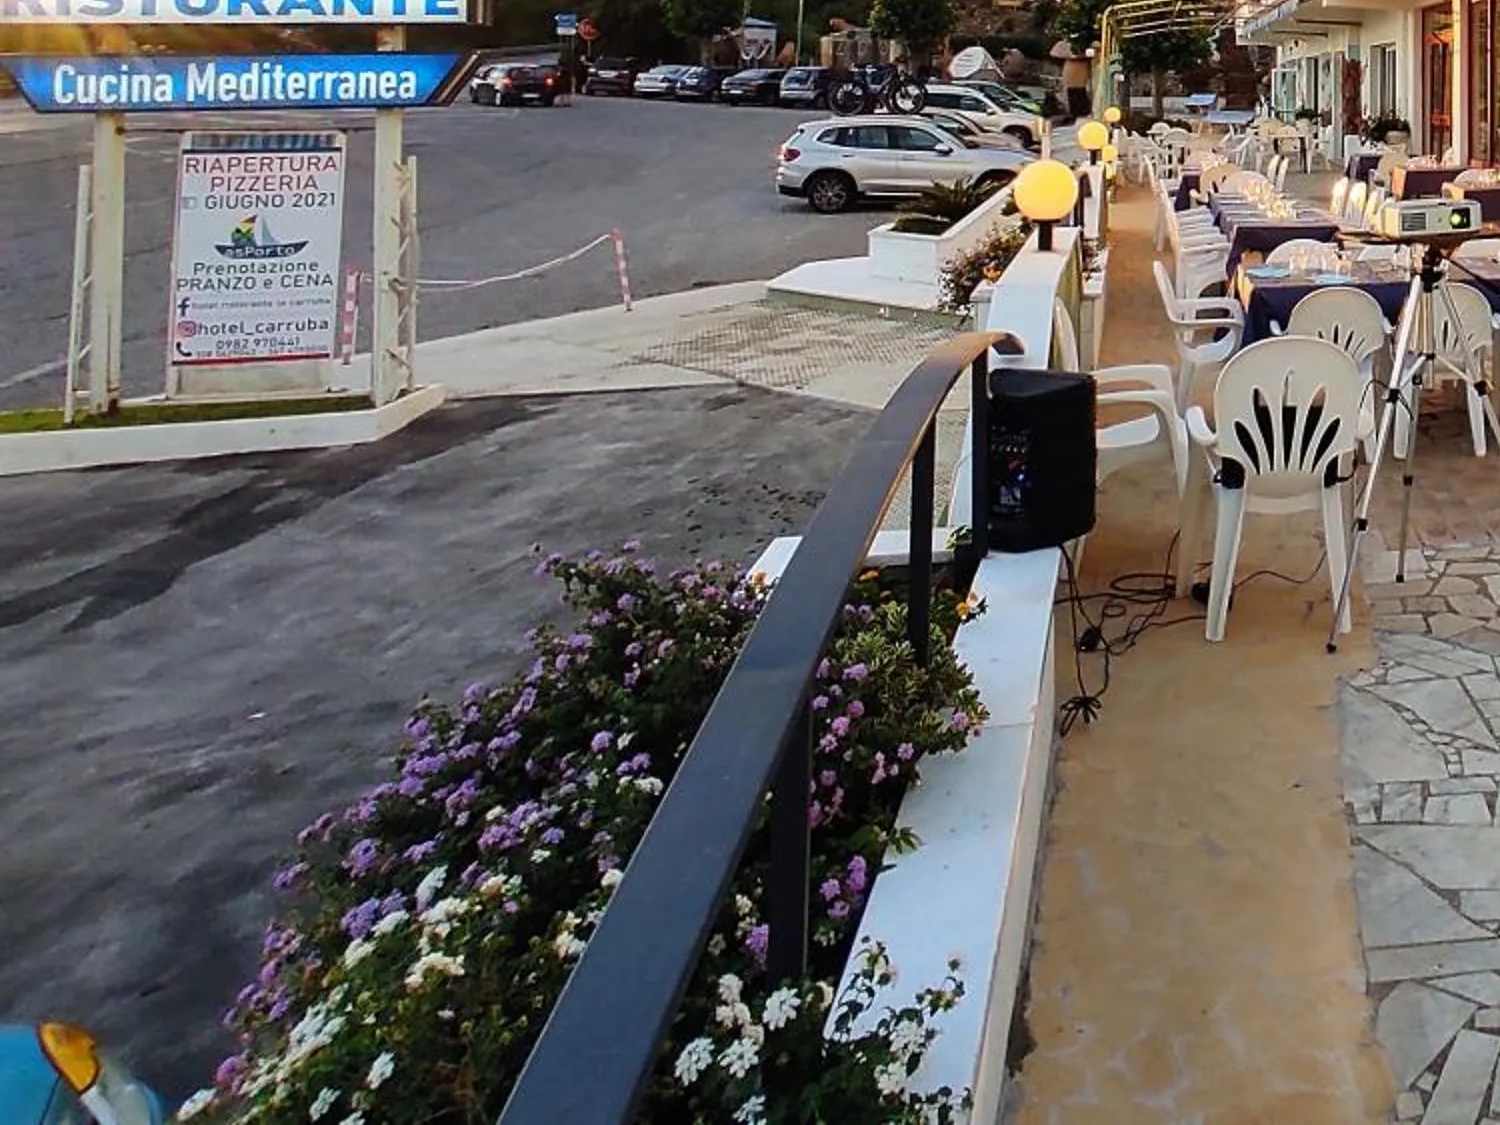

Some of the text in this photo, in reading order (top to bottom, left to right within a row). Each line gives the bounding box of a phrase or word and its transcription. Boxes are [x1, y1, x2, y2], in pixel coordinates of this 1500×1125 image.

[54, 62, 418, 105] Cucina Mediterranea
[185, 155, 338, 174] RIAPERTURA
[210, 175, 319, 192] PIZZERIA
[204, 194, 285, 210] GIUGNO
[291, 192, 336, 208] 2021
[193, 261, 319, 276] Prenotazione
[176, 274, 334, 292] PRANZO e CENA
[199, 317, 330, 335] hotel_carruba
